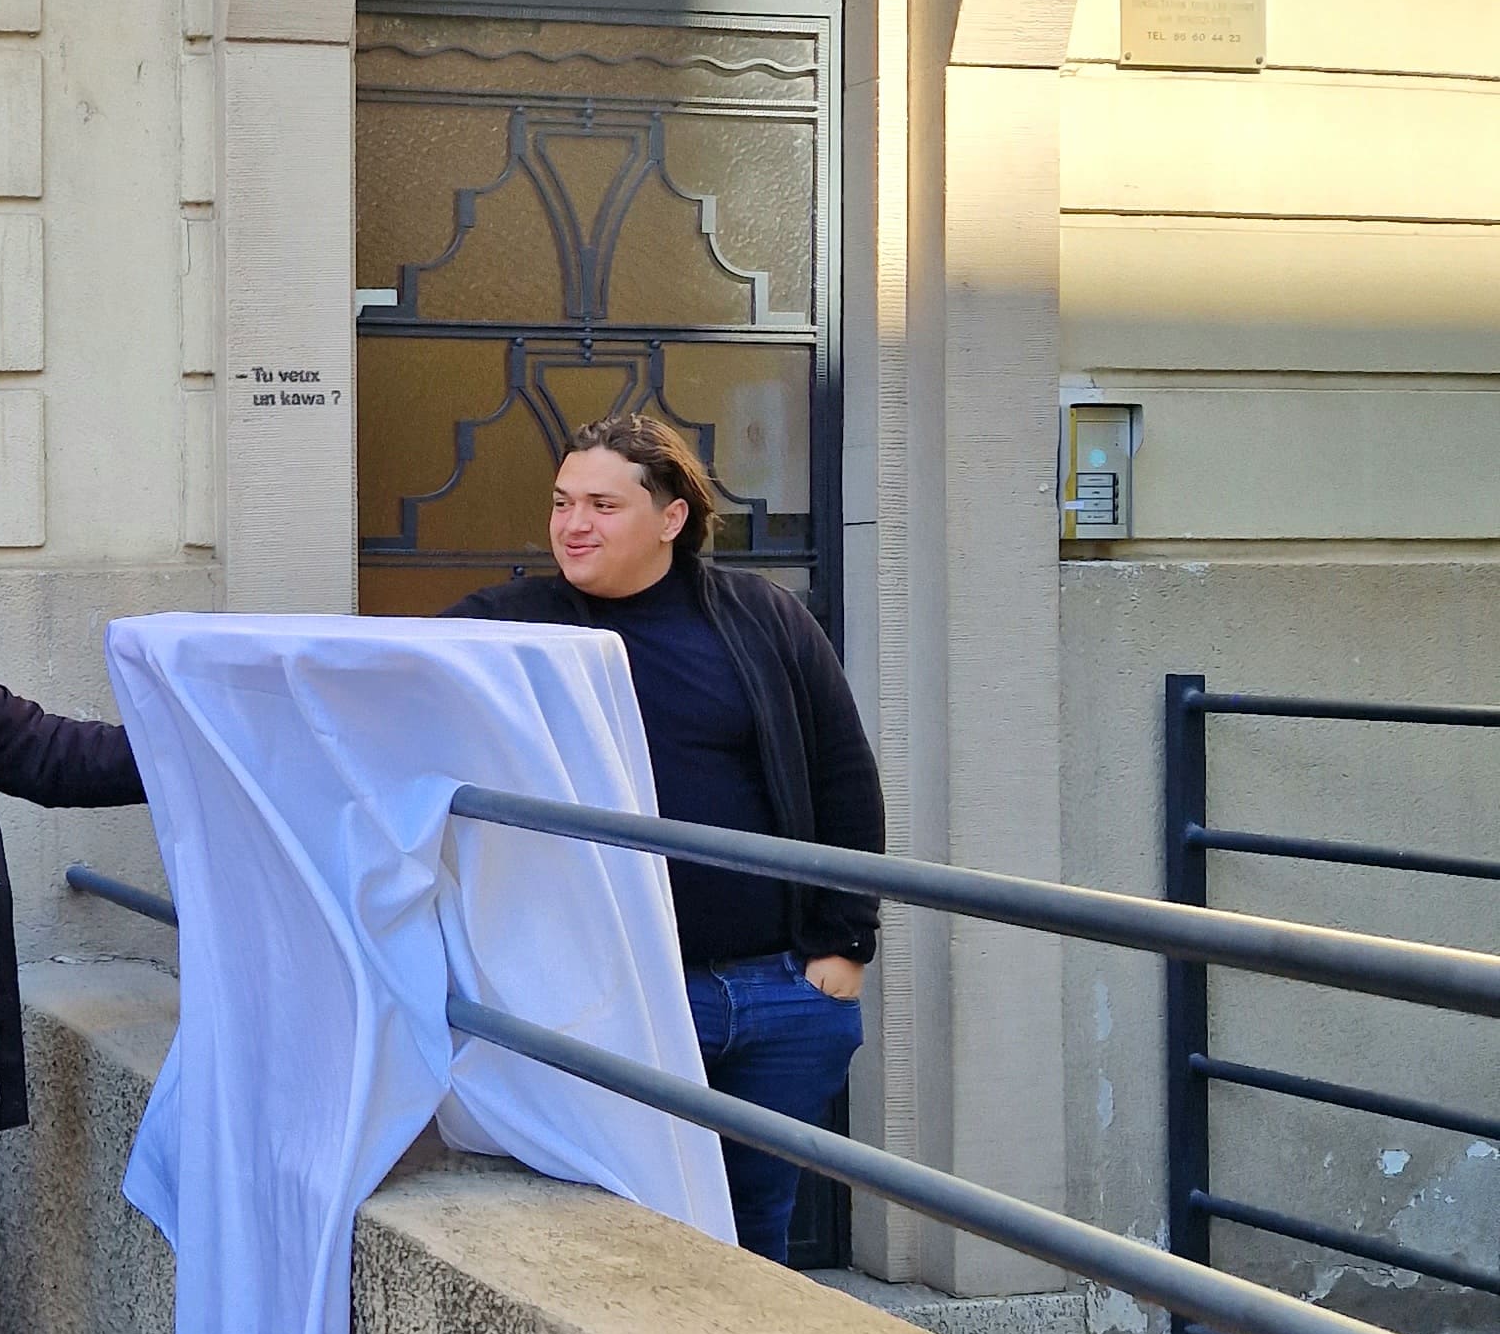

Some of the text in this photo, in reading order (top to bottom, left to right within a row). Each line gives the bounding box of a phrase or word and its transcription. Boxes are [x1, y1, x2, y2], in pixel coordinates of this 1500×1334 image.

[251, 367, 273, 383] Tu
[278, 369, 321, 383] veux
[253, 390, 341, 406] un kawa ?
